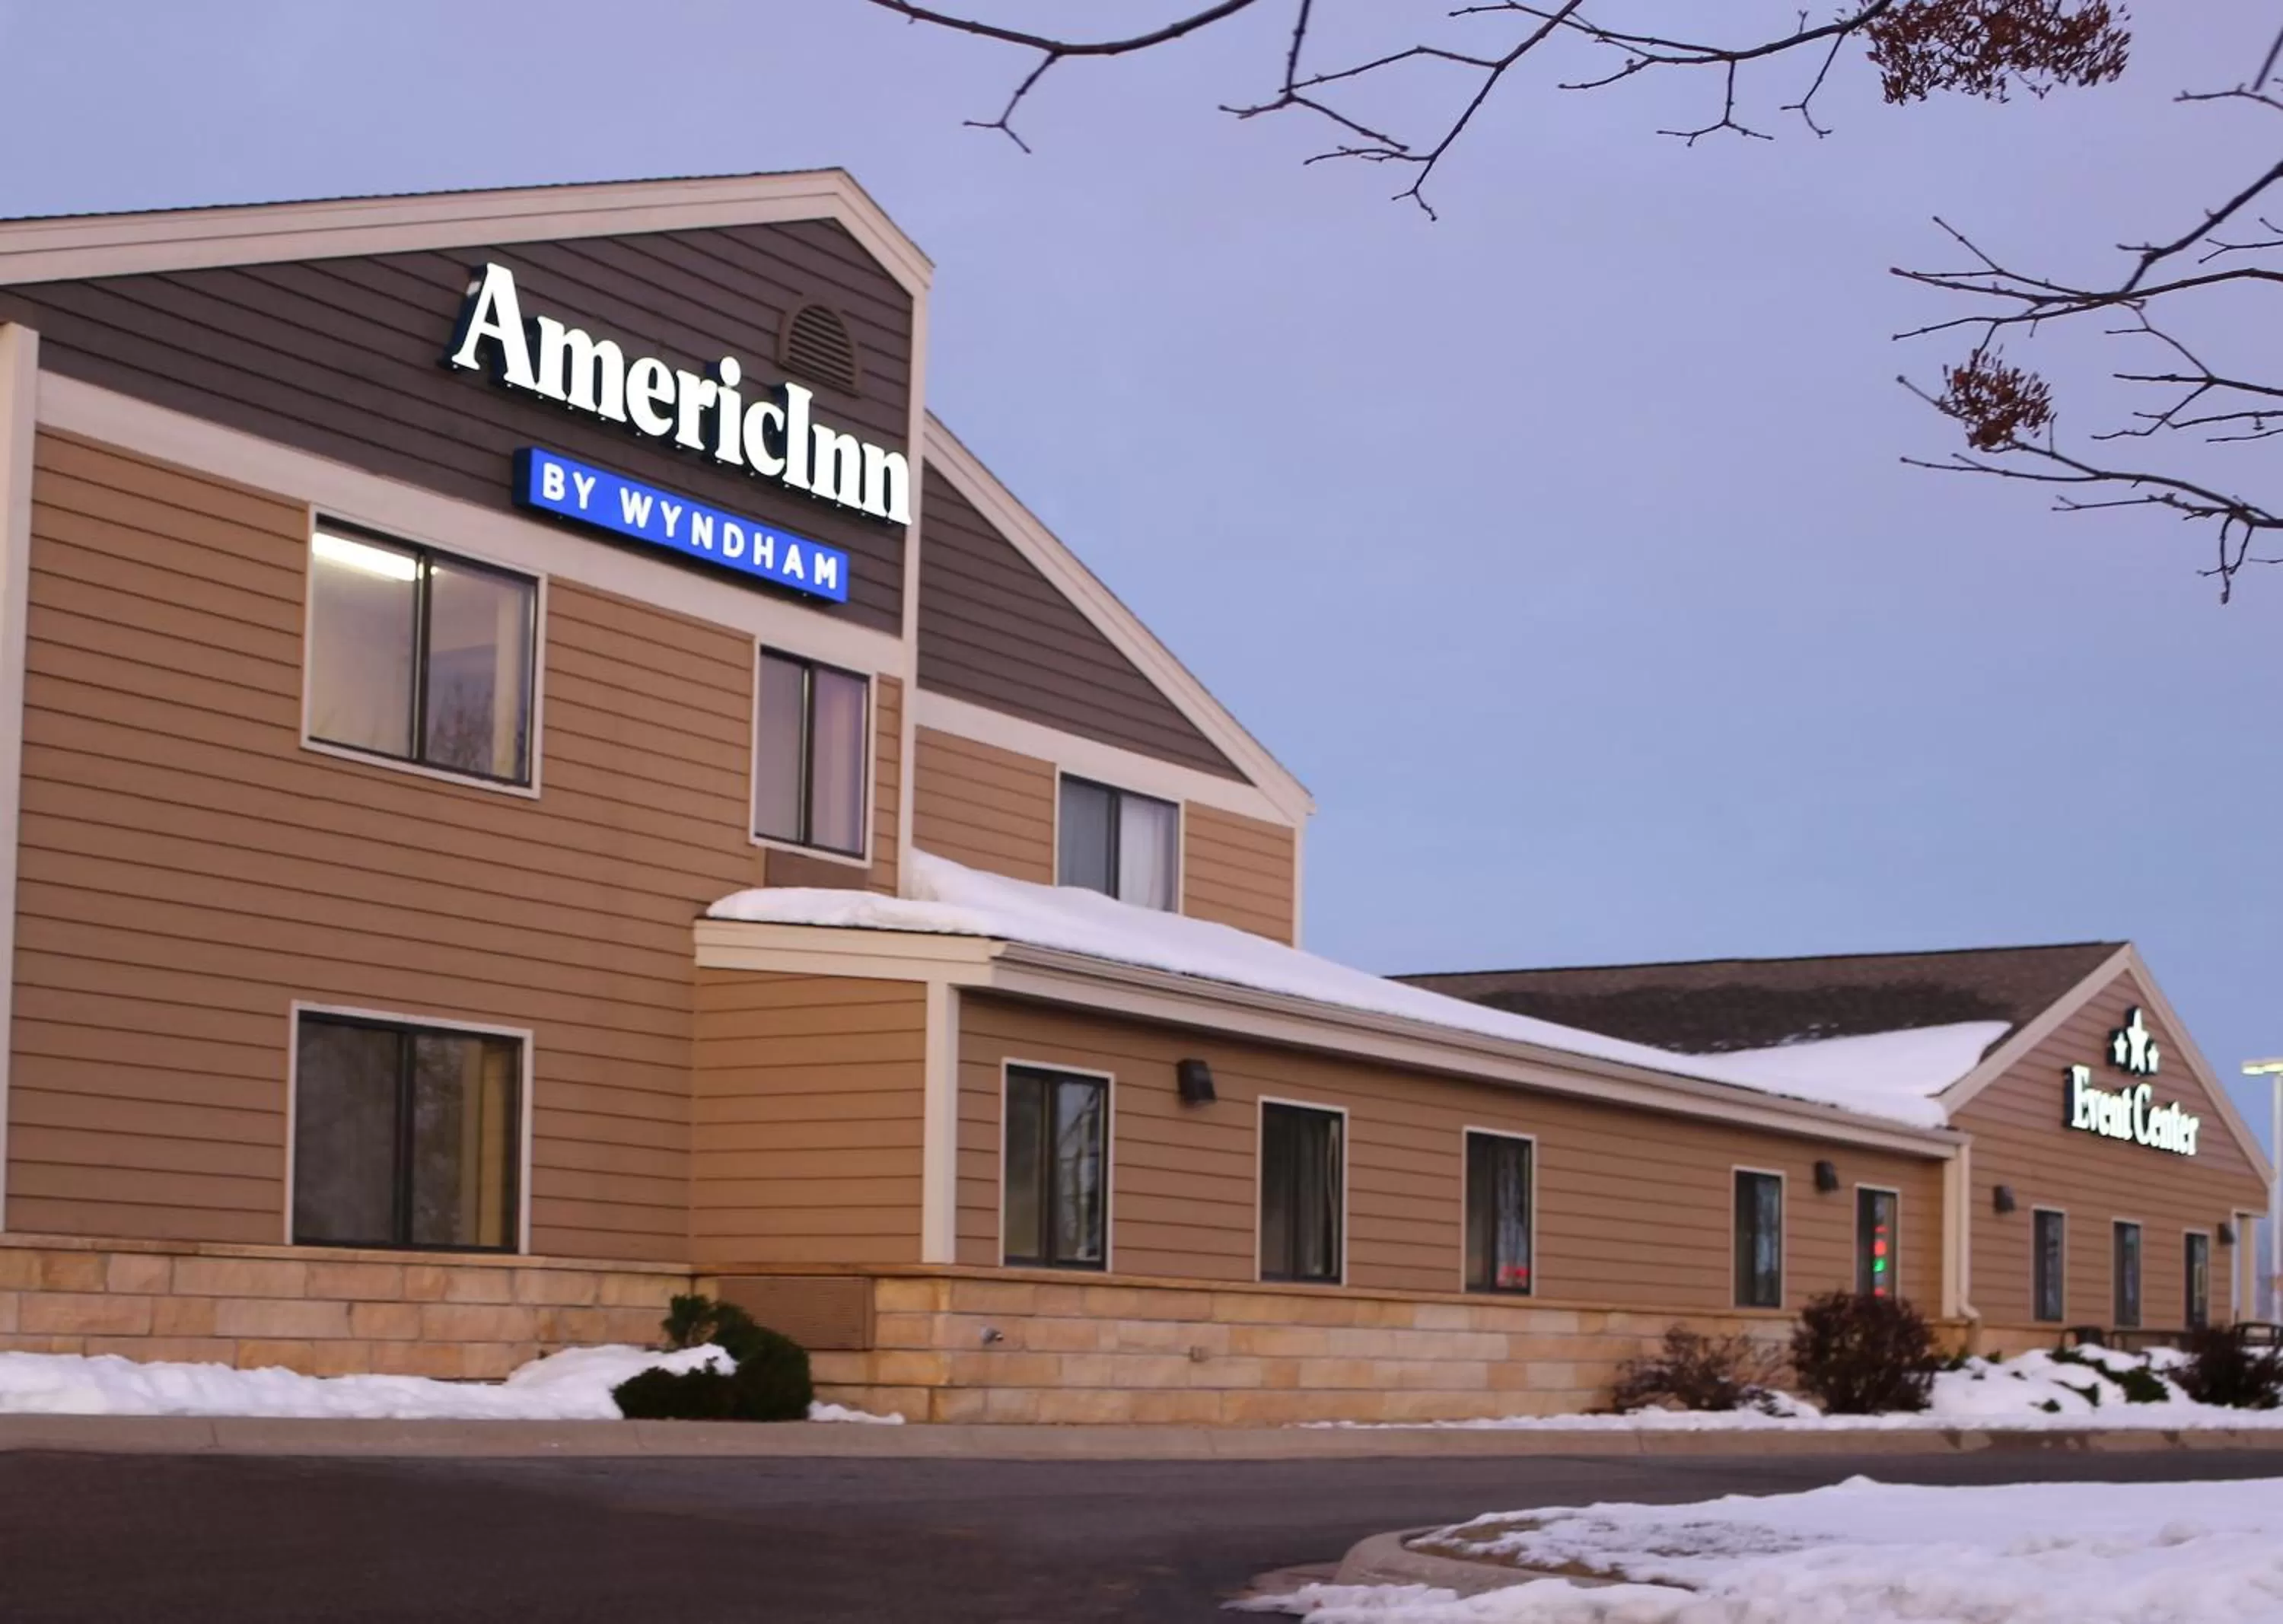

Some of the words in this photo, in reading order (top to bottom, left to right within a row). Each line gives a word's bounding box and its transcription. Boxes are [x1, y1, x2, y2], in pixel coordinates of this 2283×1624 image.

[452, 262, 912, 525] AmericInn
[542, 462, 596, 509] BY
[619, 487, 837, 589] WYNDHAM
[2071, 1065, 2132, 1141] Event
[2133, 1083, 2200, 1156] Center
